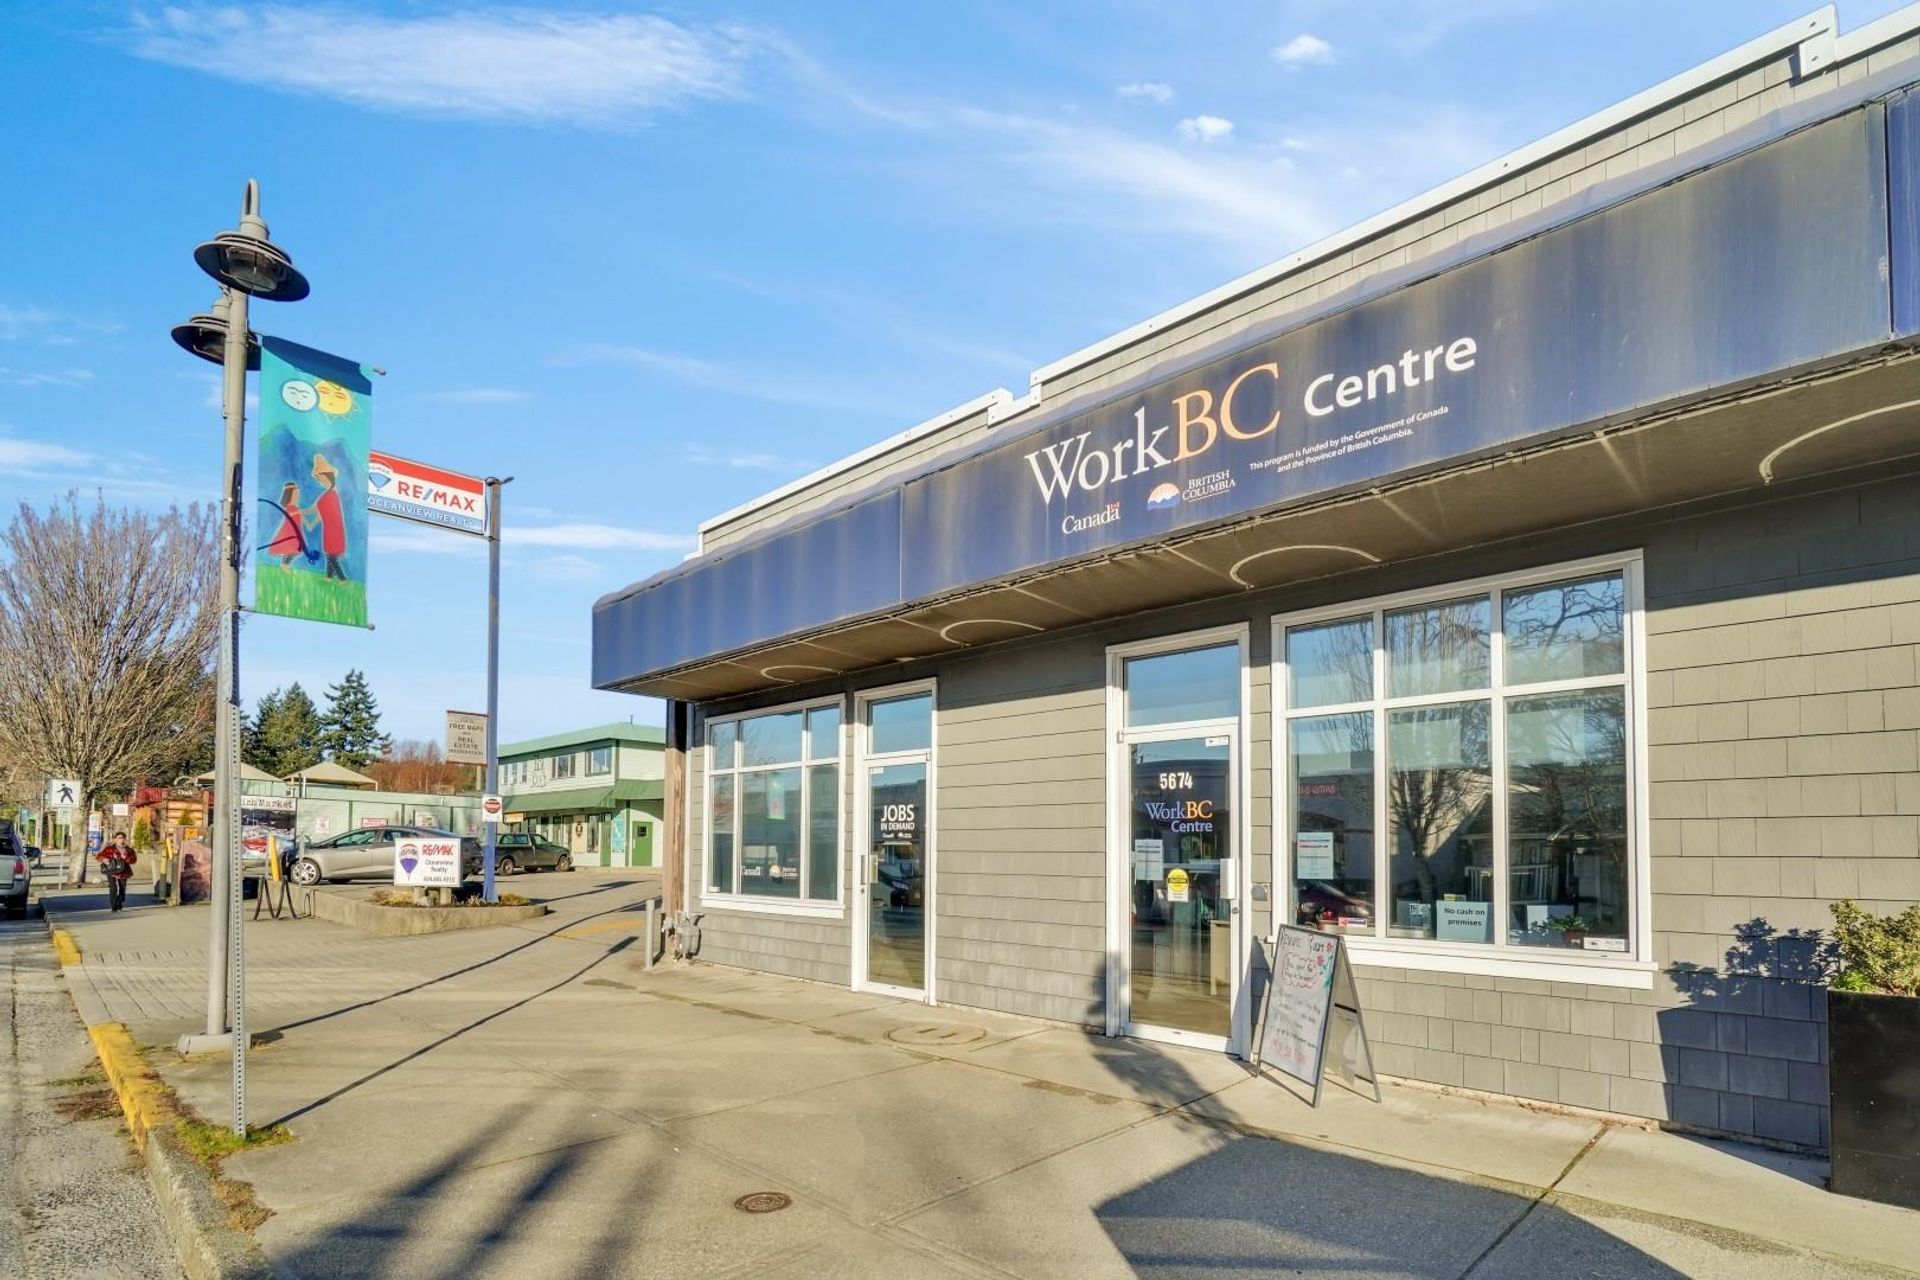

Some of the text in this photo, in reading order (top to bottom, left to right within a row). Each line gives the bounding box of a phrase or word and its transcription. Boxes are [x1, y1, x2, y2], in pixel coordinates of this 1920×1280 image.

[1025, 337, 1477, 504] WorkBC Centre
[1249, 406, 1449, 471] This program is funded by the Government of Canada
[1277, 429, 1413, 473] and the Province of British Columbia.
[1188, 469, 1230, 489] BRITISH
[398, 481, 475, 512] RE/MAX
[1182, 478, 1236, 501] COLUMBIA
[368, 497, 433, 518] OCEANVIEW
[1062, 504, 1121, 534] Canada
[1160, 771, 1194, 789] 5674
[880, 804, 915, 822] JOBS
[1145, 800, 1213, 819] WorkBC
[889, 822, 915, 830] DEMAND
[1171, 820, 1213, 833] Centre
[422, 844, 454, 856] RE/MAX
[1447, 918, 1482, 927] premises
